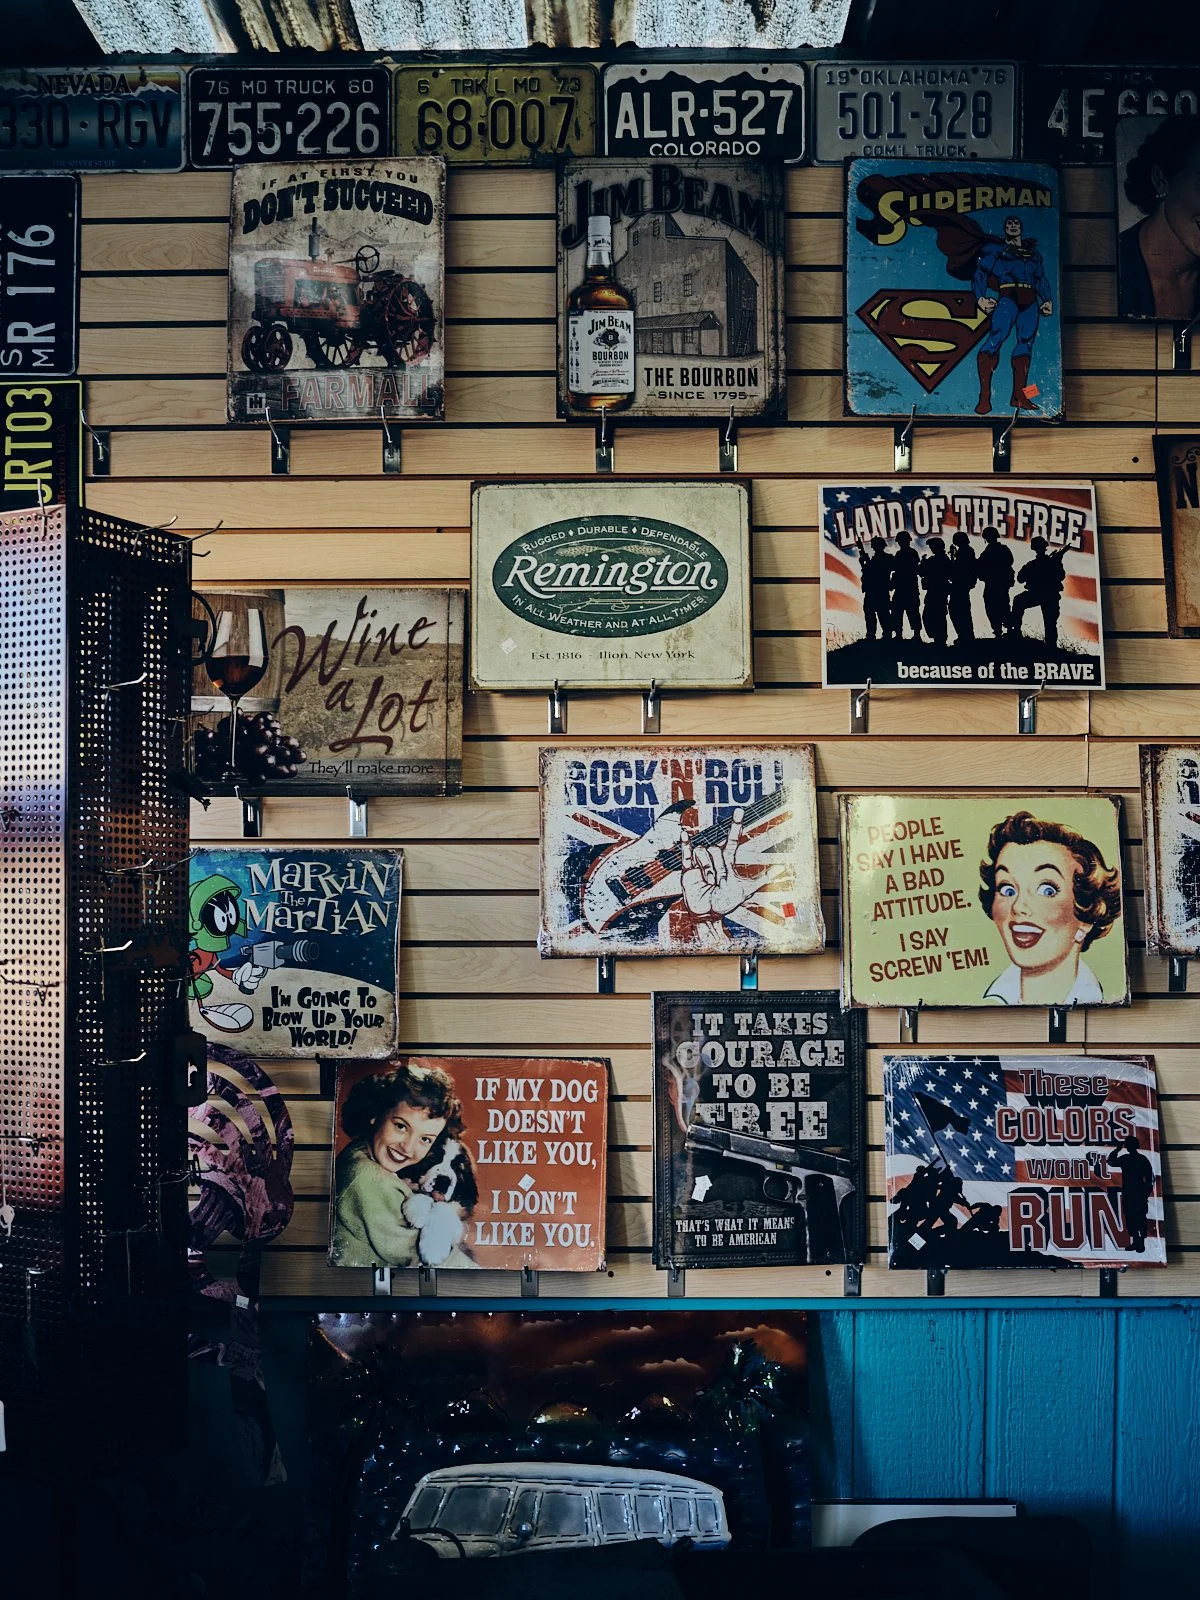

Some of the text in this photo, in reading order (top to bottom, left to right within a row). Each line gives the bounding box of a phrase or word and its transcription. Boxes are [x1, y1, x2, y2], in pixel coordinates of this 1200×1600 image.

[36, 73, 132, 95] NEVADA
[205, 80, 230, 95] 76
[242, 79, 267, 95] MO
[275, 79, 336, 95] TRUCK
[417, 79, 430, 95] 6
[451, 78, 486, 95] TRK
[513, 77, 540, 93] MO
[825, 69, 1006, 85] 19 OKLAHOMA 76
[838, 90, 993, 140] 501-328
[649, 140, 761, 158] COLORADO
[914, 144, 968, 157] TRUCK
[262, 167, 419, 191] IF AT FIRST YOU
[242, 178, 434, 235] DON'T SUCCEED
[561, 163, 769, 250] JIM BEAM
[588, 315, 632, 336] JIM BEAM
[592, 350, 629, 361] BOURBON
[644, 367, 674, 387] THE
[680, 367, 759, 388] BOURBON
[281, 373, 437, 411] FARMALL
[658, 390, 748, 400] SINCE 1795
[835, 495, 1086, 549] LAND OF THE FREE
[522, 526, 709, 562] RUGGED DURABLE DEPENDABLE
[501, 553, 719, 600] Remington
[512, 594, 705, 629] IN ALL WEATHER AND AT ALL TIMES
[271, 594, 437, 694] Wine
[634, 651, 663, 660] New
[665, 650, 696, 660] York
[897, 662, 1095, 681] because of the BRAVE
[324, 677, 355, 713] a
[329, 675, 440, 755] Lot
[309, 760, 434, 777] They'll make more
[564, 758, 660, 806] ROCK
[867, 817, 945, 845] PEOPLE
[856, 839, 964, 872] SAY I HAVE
[885, 867, 945, 895] A BAD
[280, 890, 306, 907] The
[873, 889, 972, 922] ATTITUDE.
[899, 927, 950, 952] I SAY
[869, 954, 944, 983] SCREW
[297, 986, 351, 1009] GOING
[356, 986, 378, 1009] TO
[262, 1006, 385, 1032] BLOW UP YOUR
[691, 1012, 829, 1037] IT TAKES
[288, 1026, 358, 1050] WORLD!
[676, 1039, 845, 1069] COURAGE
[474, 1077, 599, 1103] IF MY DOG
[712, 1072, 811, 1099] TO BE
[1018, 1067, 1110, 1097] These
[486, 1108, 586, 1134] DOESN'T
[695, 1101, 828, 1141] FREE
[995, 1106, 1137, 1144] COLORS
[476, 1140, 597, 1170] LIKE YOU,
[1025, 1150, 1113, 1180] won't
[491, 1189, 577, 1215] I DON'T
[474, 1221, 596, 1248] LIKE YOU.
[676, 1218, 710, 1233] THAT'S
[715, 1218, 744, 1232] WHAT
[748, 1217, 758, 1231] IT
[1008, 1191, 1133, 1252] RUN
[694, 1232, 777, 1247] TO BE AMERICAN
